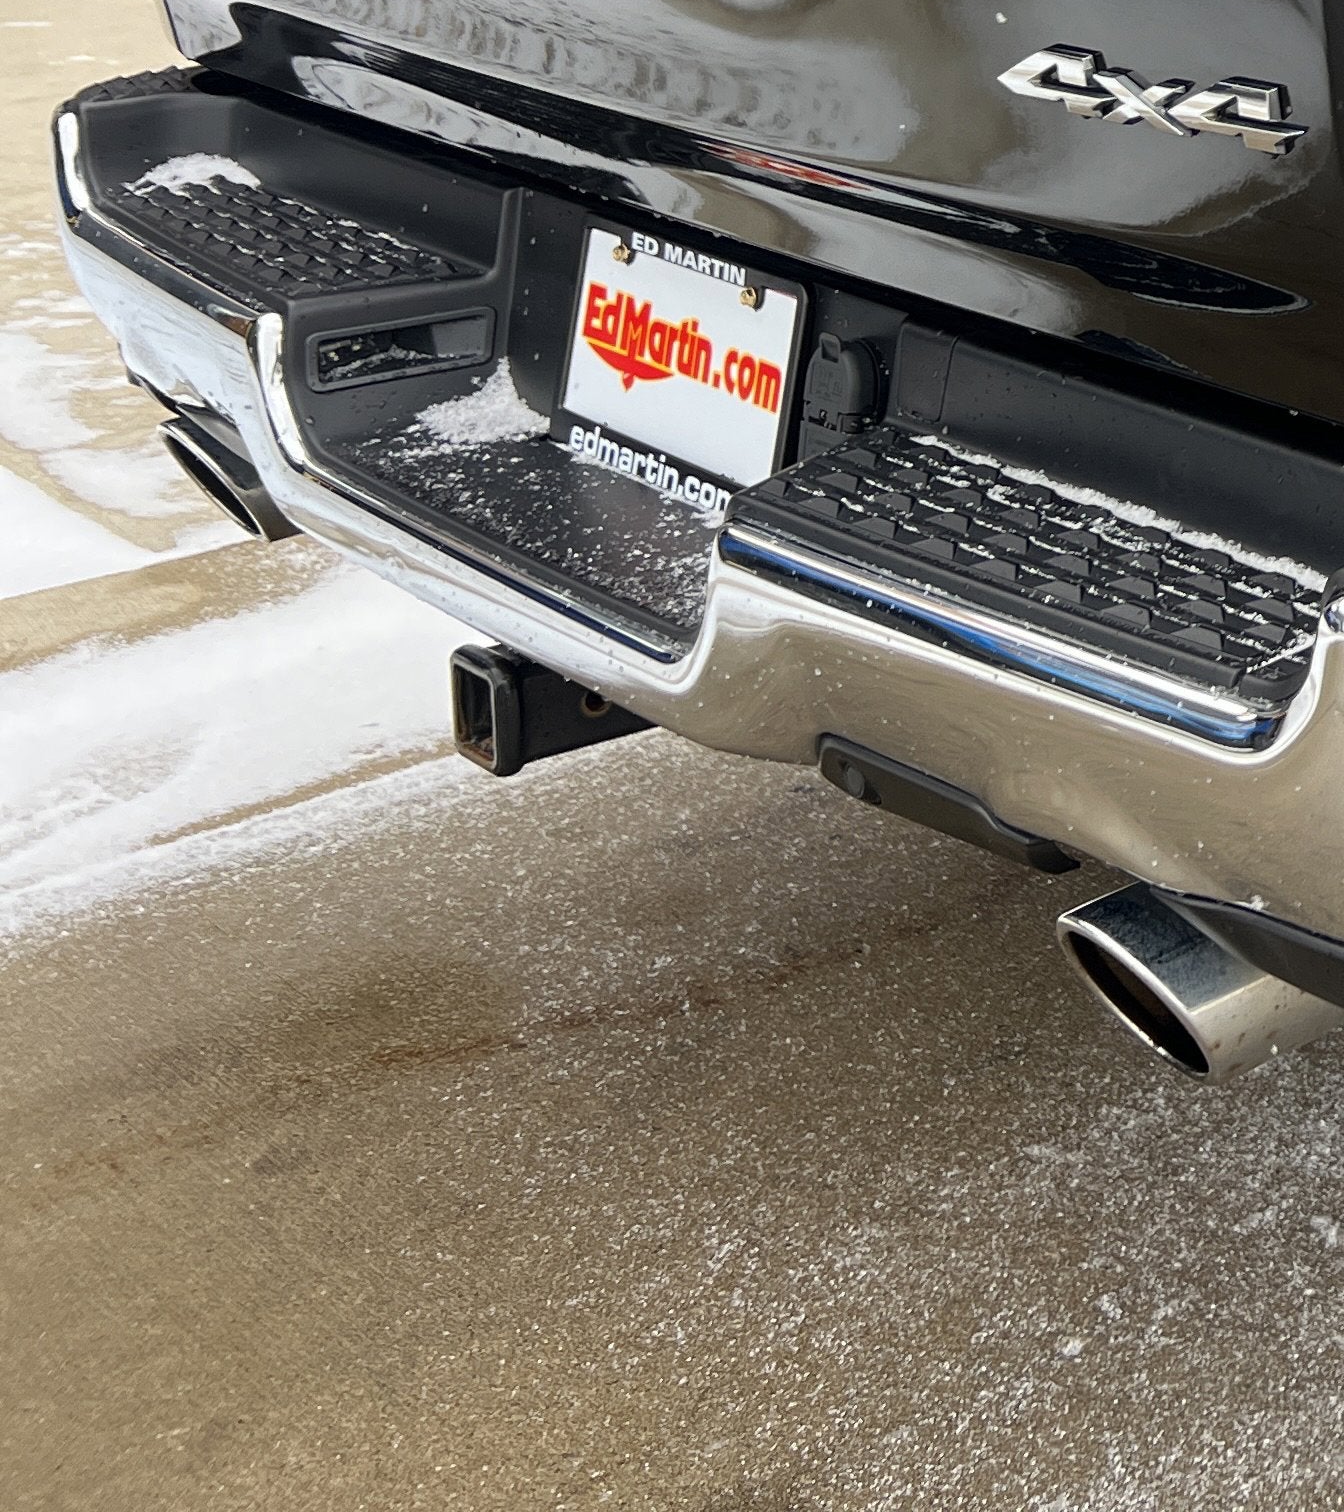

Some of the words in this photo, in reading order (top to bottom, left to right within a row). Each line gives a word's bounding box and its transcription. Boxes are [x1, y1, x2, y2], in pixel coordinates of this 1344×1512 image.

[631, 232, 659, 256] ED
[663, 243, 747, 286] MARTIN
[582, 282, 782, 414] EdMartin.com
